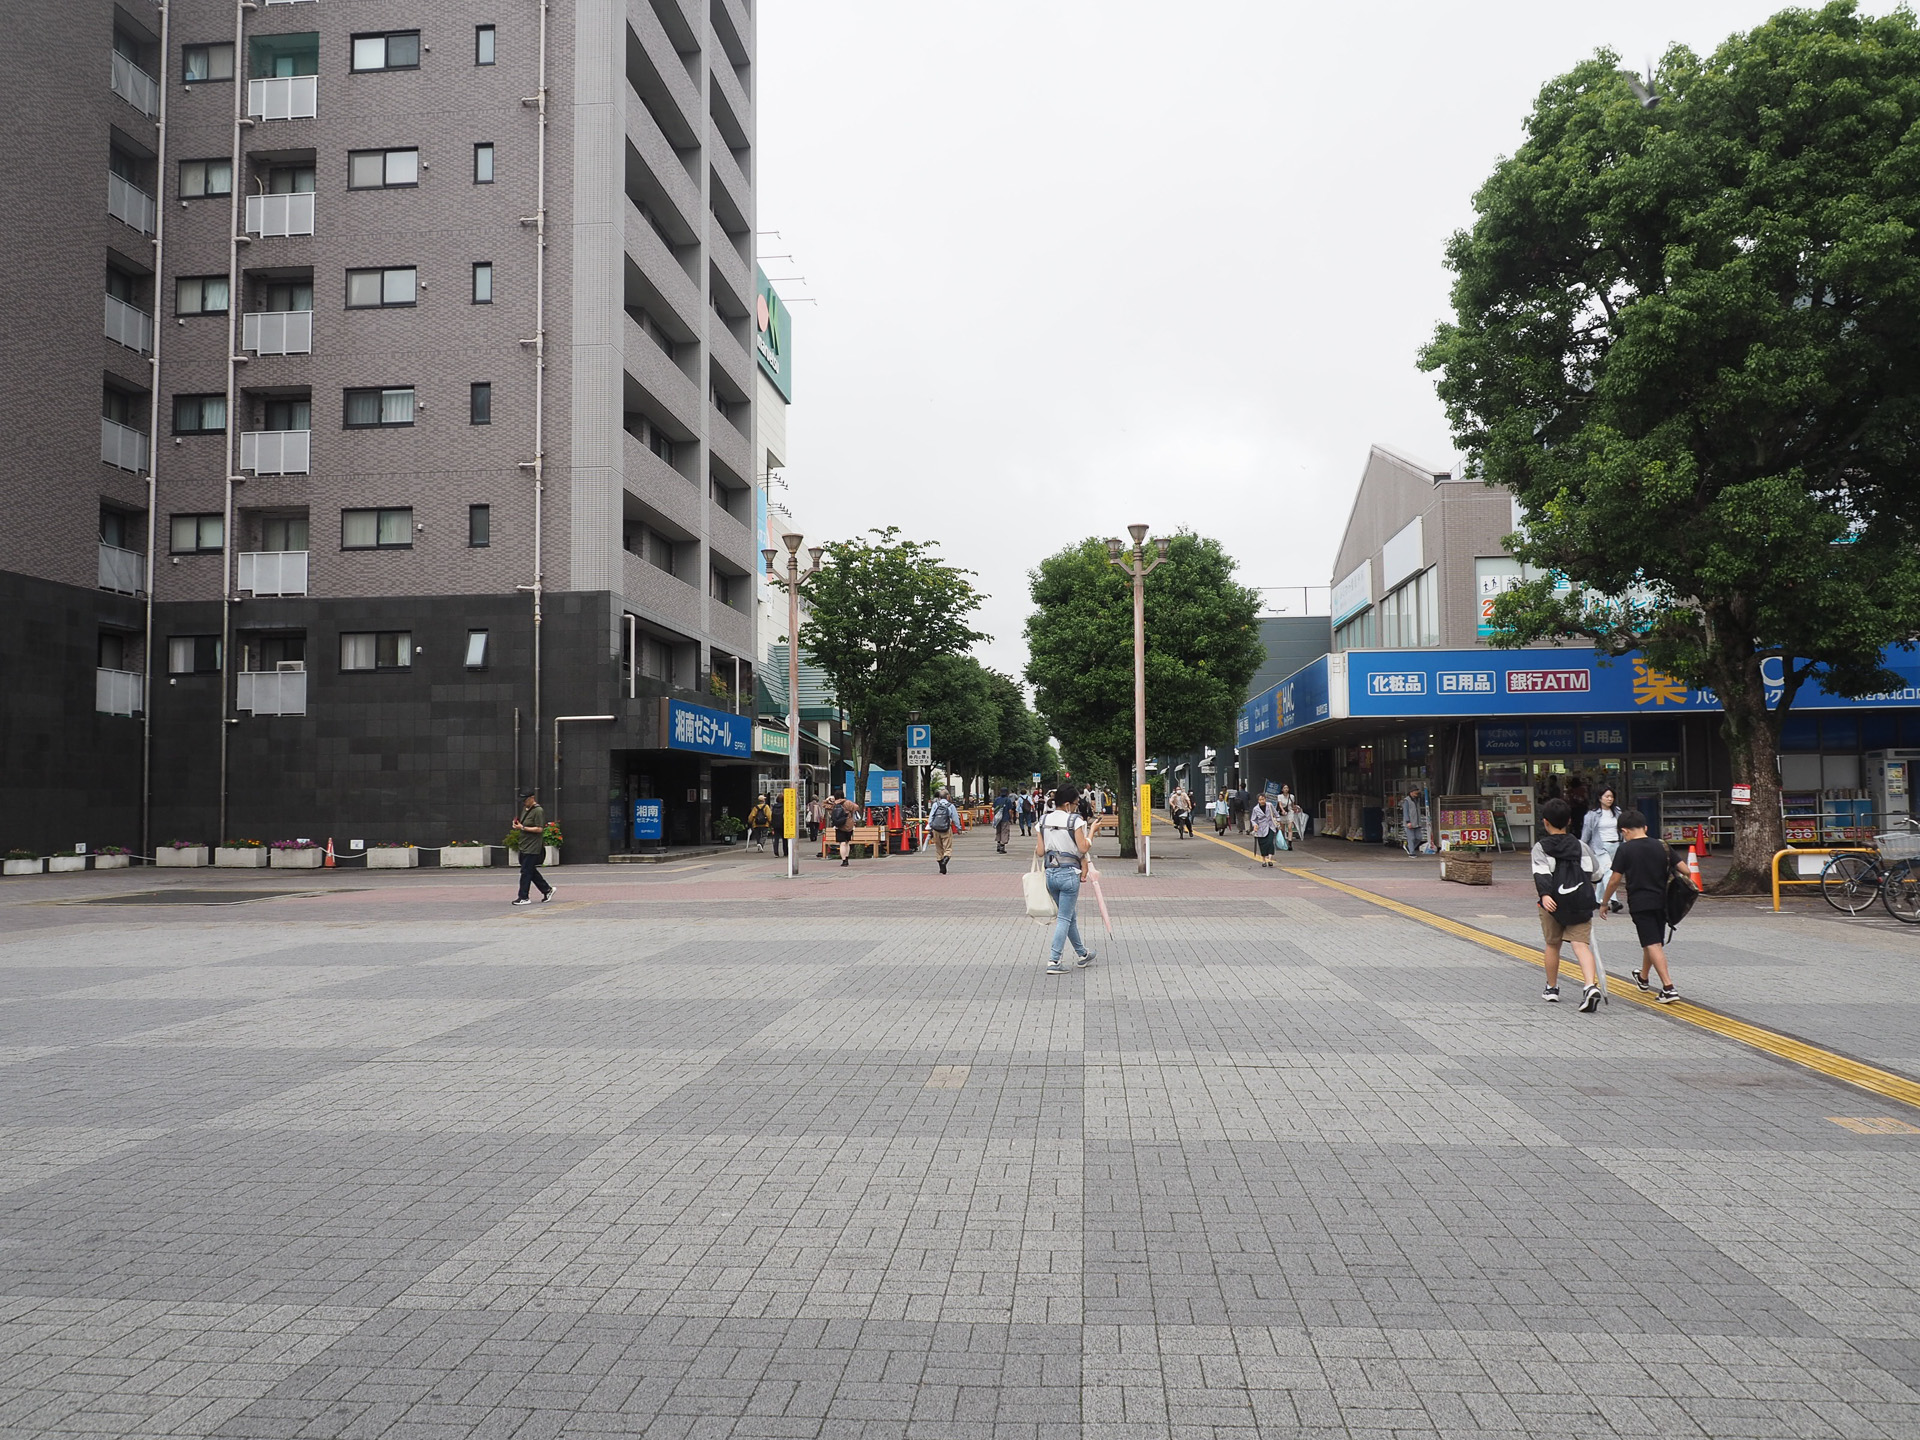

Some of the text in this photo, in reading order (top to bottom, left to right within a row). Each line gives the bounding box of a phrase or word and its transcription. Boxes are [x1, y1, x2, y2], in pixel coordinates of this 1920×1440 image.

[1373, 674, 1422, 693] 化粧品
[1442, 673, 1491, 692] 日用品
[1510, 672, 1587, 692] 銀行ATM
[675, 709, 732, 748] 湘南ゼミナール
[912, 727, 927, 747] P
[1583, 729, 1623, 744] 日用品
[1486, 740, 1520, 748] Kanebo
[636, 805, 659, 817] 湘南
[1463, 830, 1488, 841] 198
